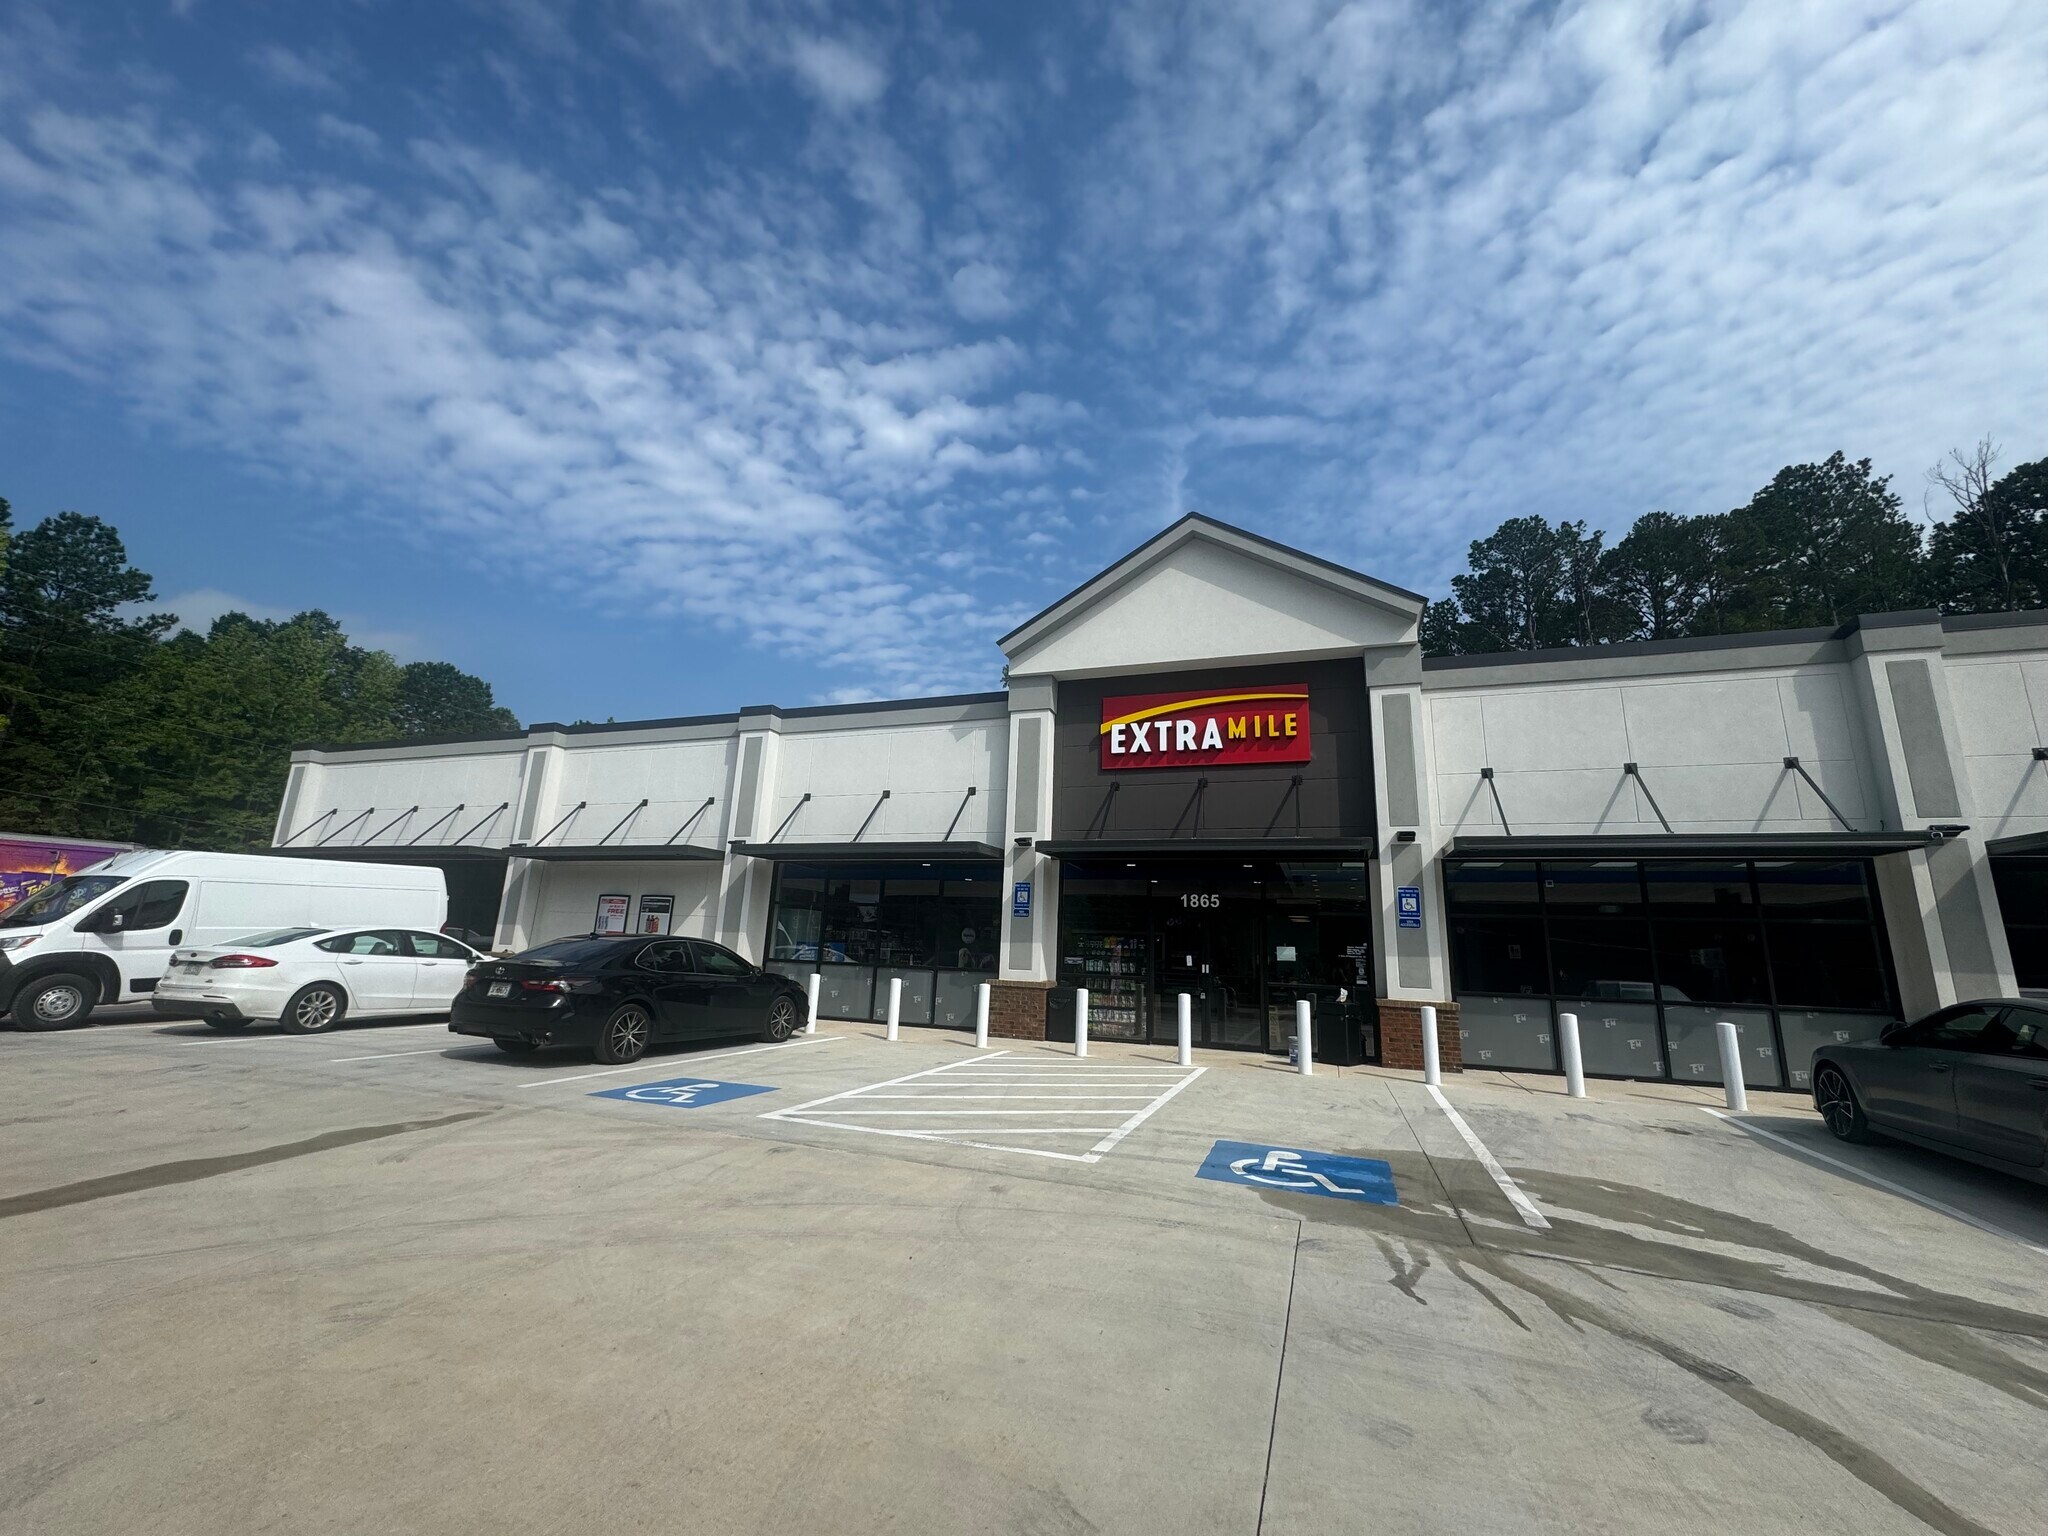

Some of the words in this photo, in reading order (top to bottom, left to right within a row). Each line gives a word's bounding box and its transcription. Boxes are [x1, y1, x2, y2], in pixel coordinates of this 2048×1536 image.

[1111, 718, 1223, 754] EXTRA
[1228, 713, 1297, 739] MILE
[1180, 894, 1220, 907] 1865
